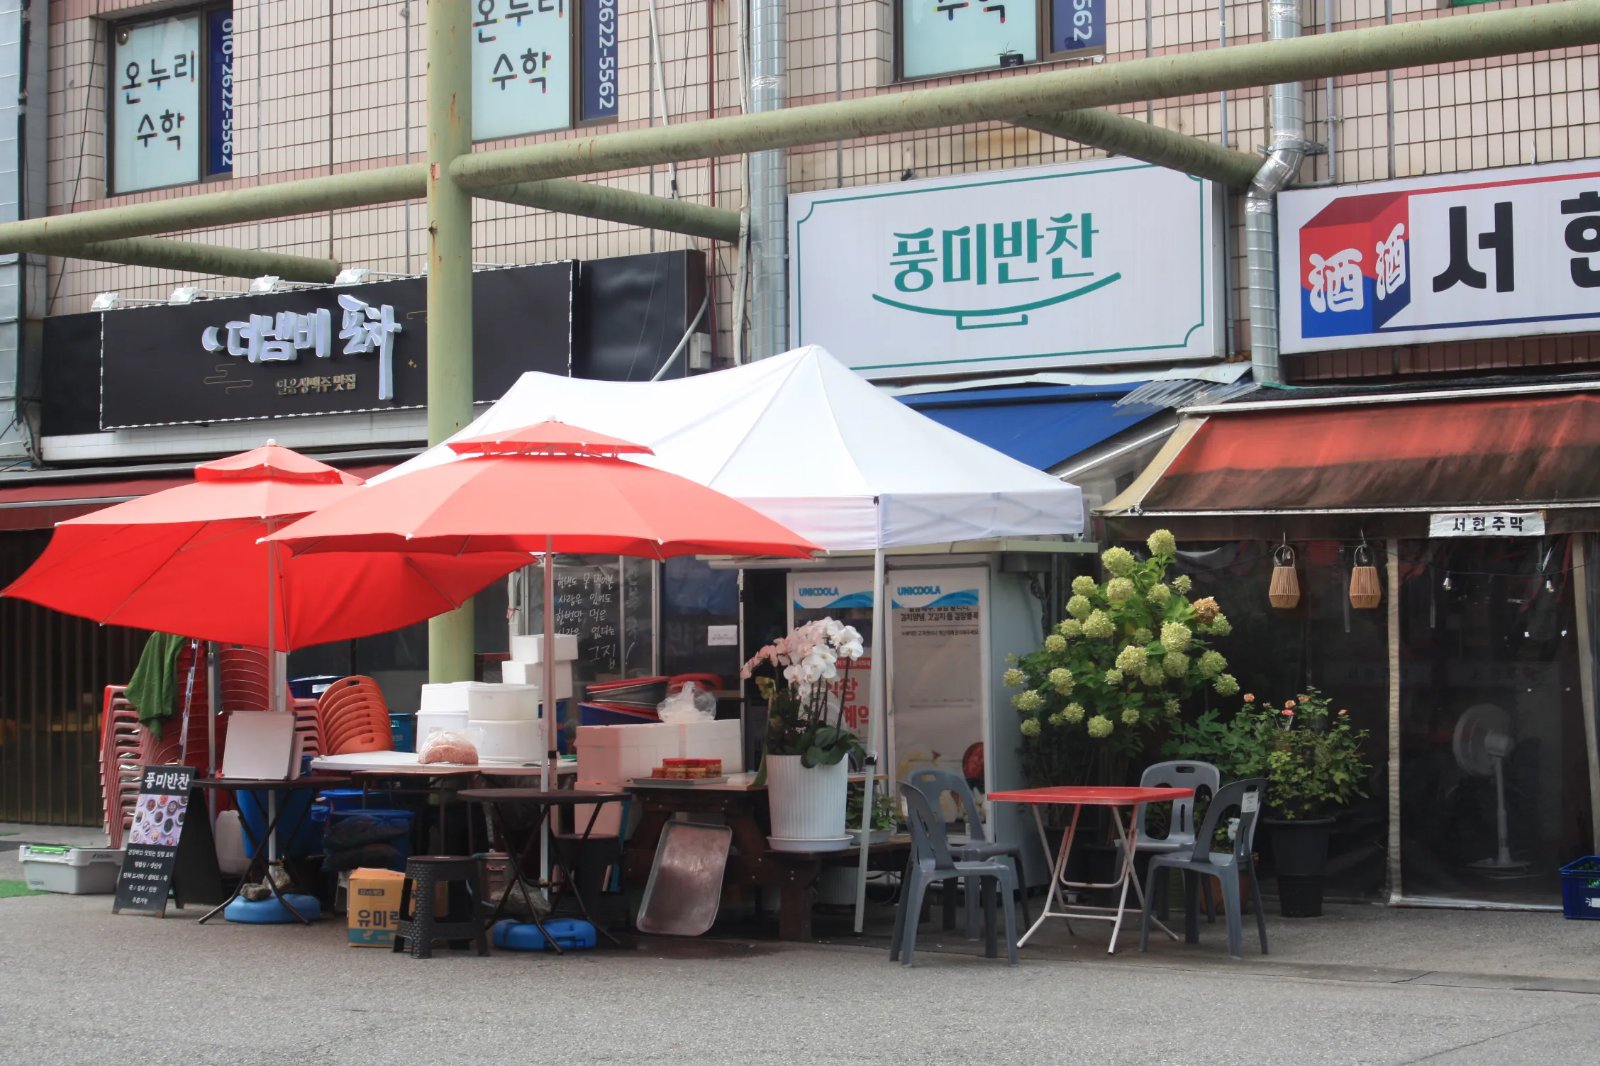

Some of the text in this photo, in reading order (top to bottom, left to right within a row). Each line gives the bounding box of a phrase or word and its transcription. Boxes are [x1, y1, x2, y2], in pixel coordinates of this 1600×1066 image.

[121, 50, 195, 105] 온누리
[221, 18, 233, 167] 010-2622-5562
[489, 47, 552, 94] 수학
[134, 109, 186, 151] 수학
[889, 212, 1099, 293] 풍미반찬
[1308, 248, 1364, 314] 酒
[1452, 516, 1524, 532] 서현주막
[798, 587, 839, 597] UNICOOLA
[897, 585, 941, 596] UNICOOLA
[144, 772, 190, 790] 풍미반찬
